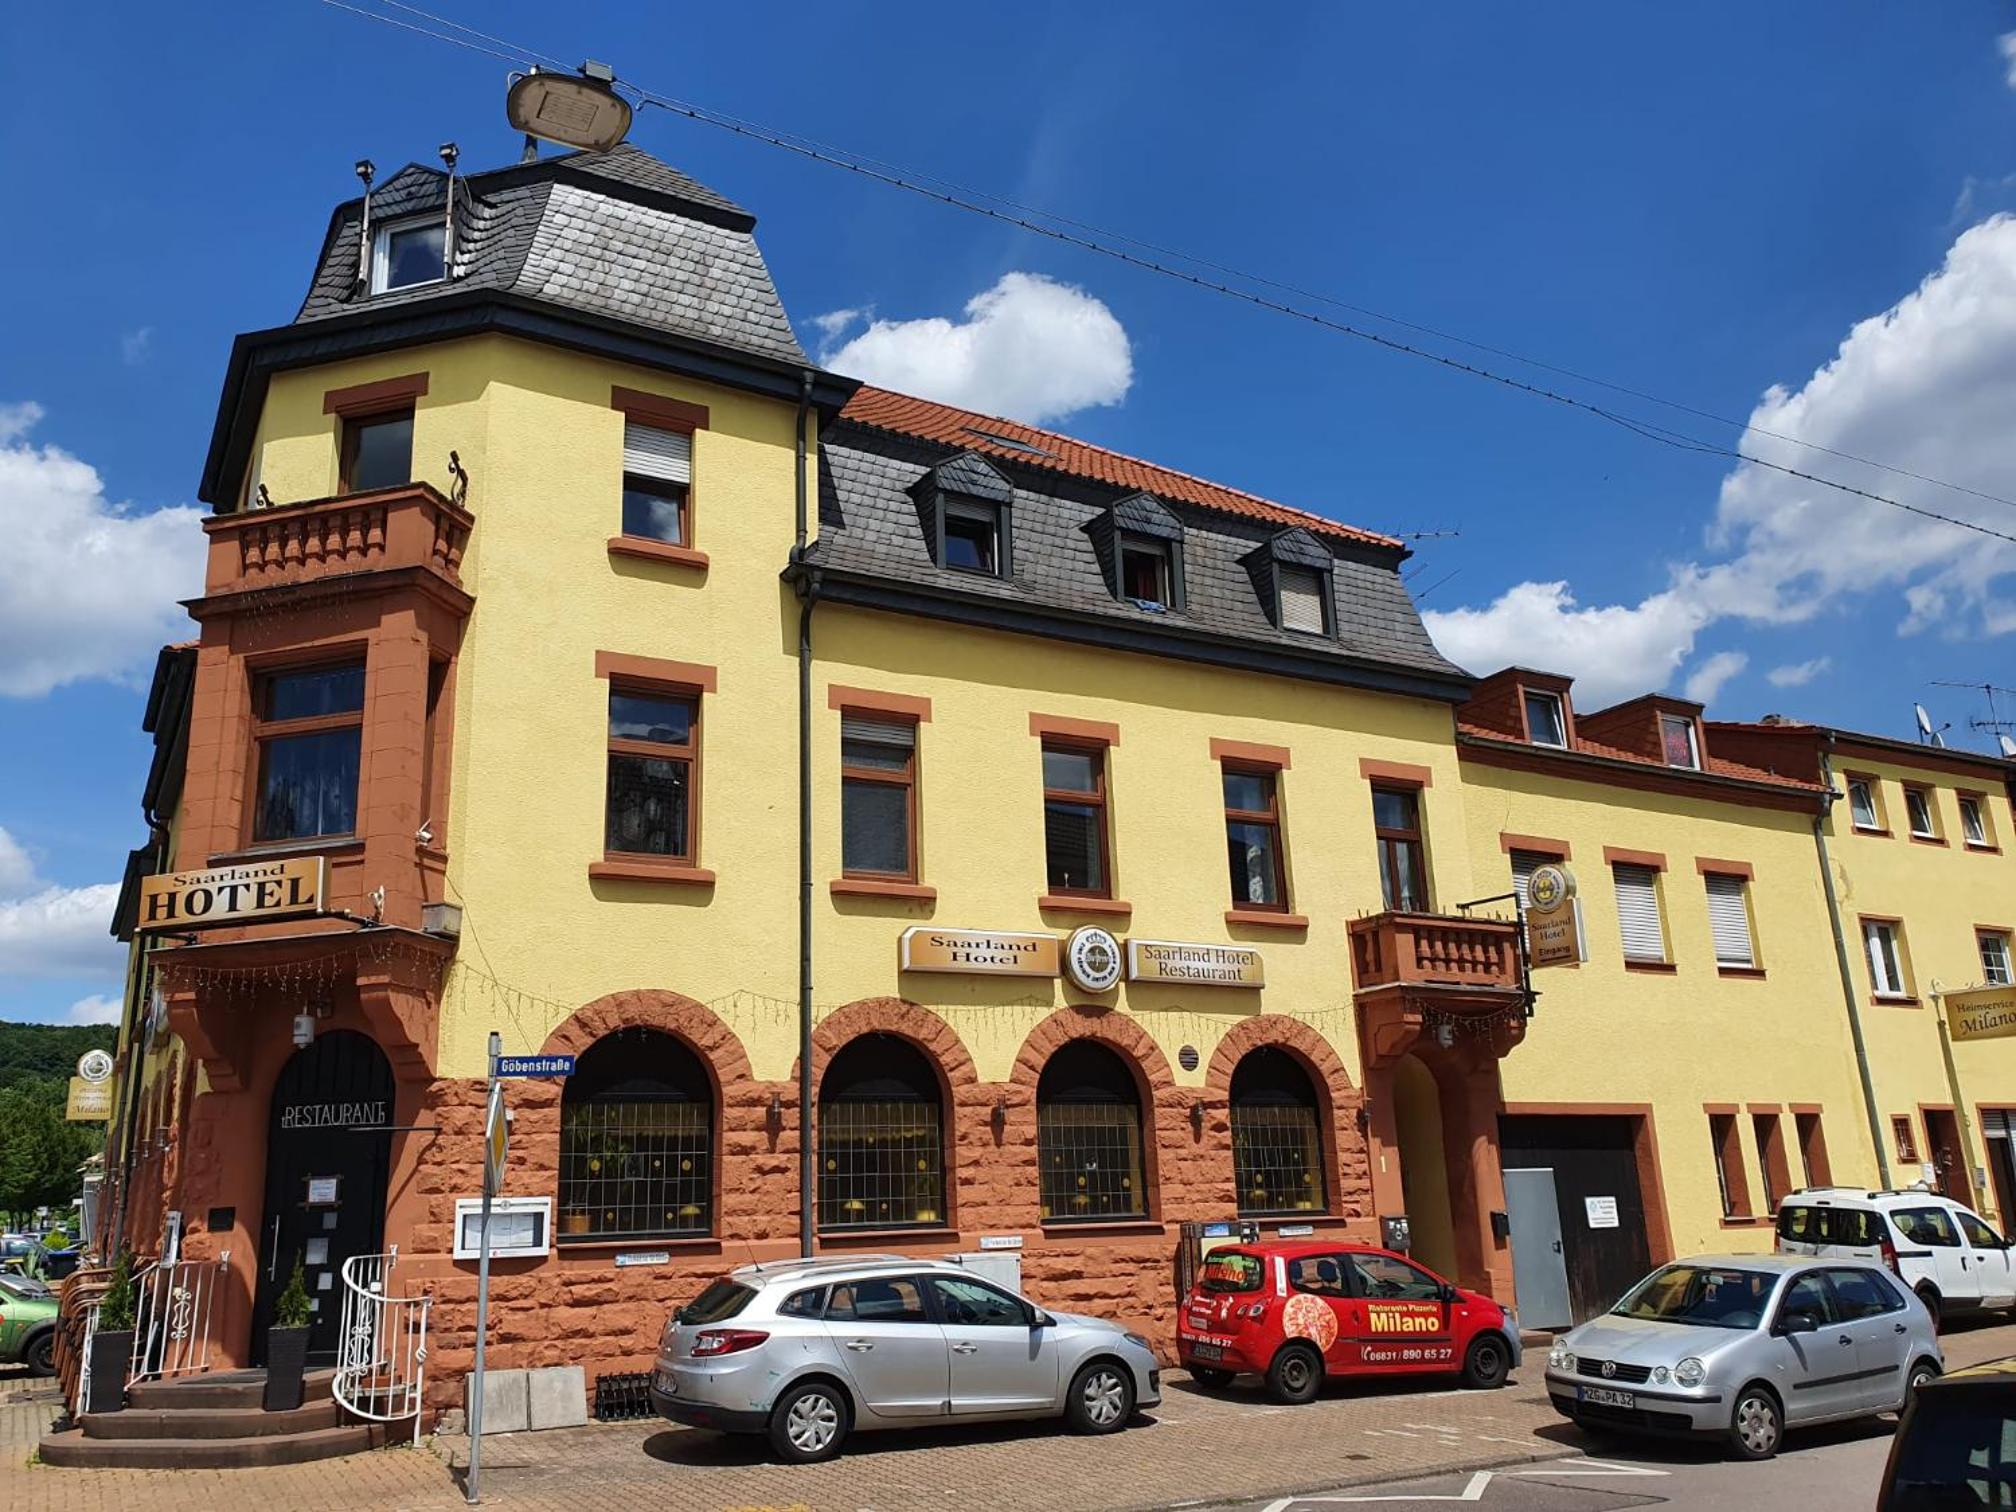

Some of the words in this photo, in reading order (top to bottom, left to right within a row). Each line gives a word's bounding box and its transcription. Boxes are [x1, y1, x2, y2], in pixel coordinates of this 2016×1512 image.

[173, 864, 285, 887] Saarland
[145, 876, 314, 922] HOTEL
[1532, 916, 1571, 931] Saarland
[1540, 928, 1566, 940] Hotel
[930, 936, 1038, 953] Saarland
[1538, 945, 1571, 956] Eingang
[951, 951, 1019, 965] Hotel
[1144, 945, 1211, 963] Saarland
[1215, 949, 1255, 966] Hotel
[1158, 961, 1243, 981] Restaurant
[1959, 1011, 2016, 1036] Milano
[501, 1058, 571, 1073] Göbenstraße
[281, 1101, 387, 1129] RESTAURANT
[1369, 1312, 1440, 1333] Milano
[1369, 1350, 1398, 1361] 06831
[1402, 1348, 1422, 1360] 890
[1423, 1347, 1438, 1359] 65
[1439, 1347, 1453, 1359] 27
[1620, 1393, 1633, 1406] 32
